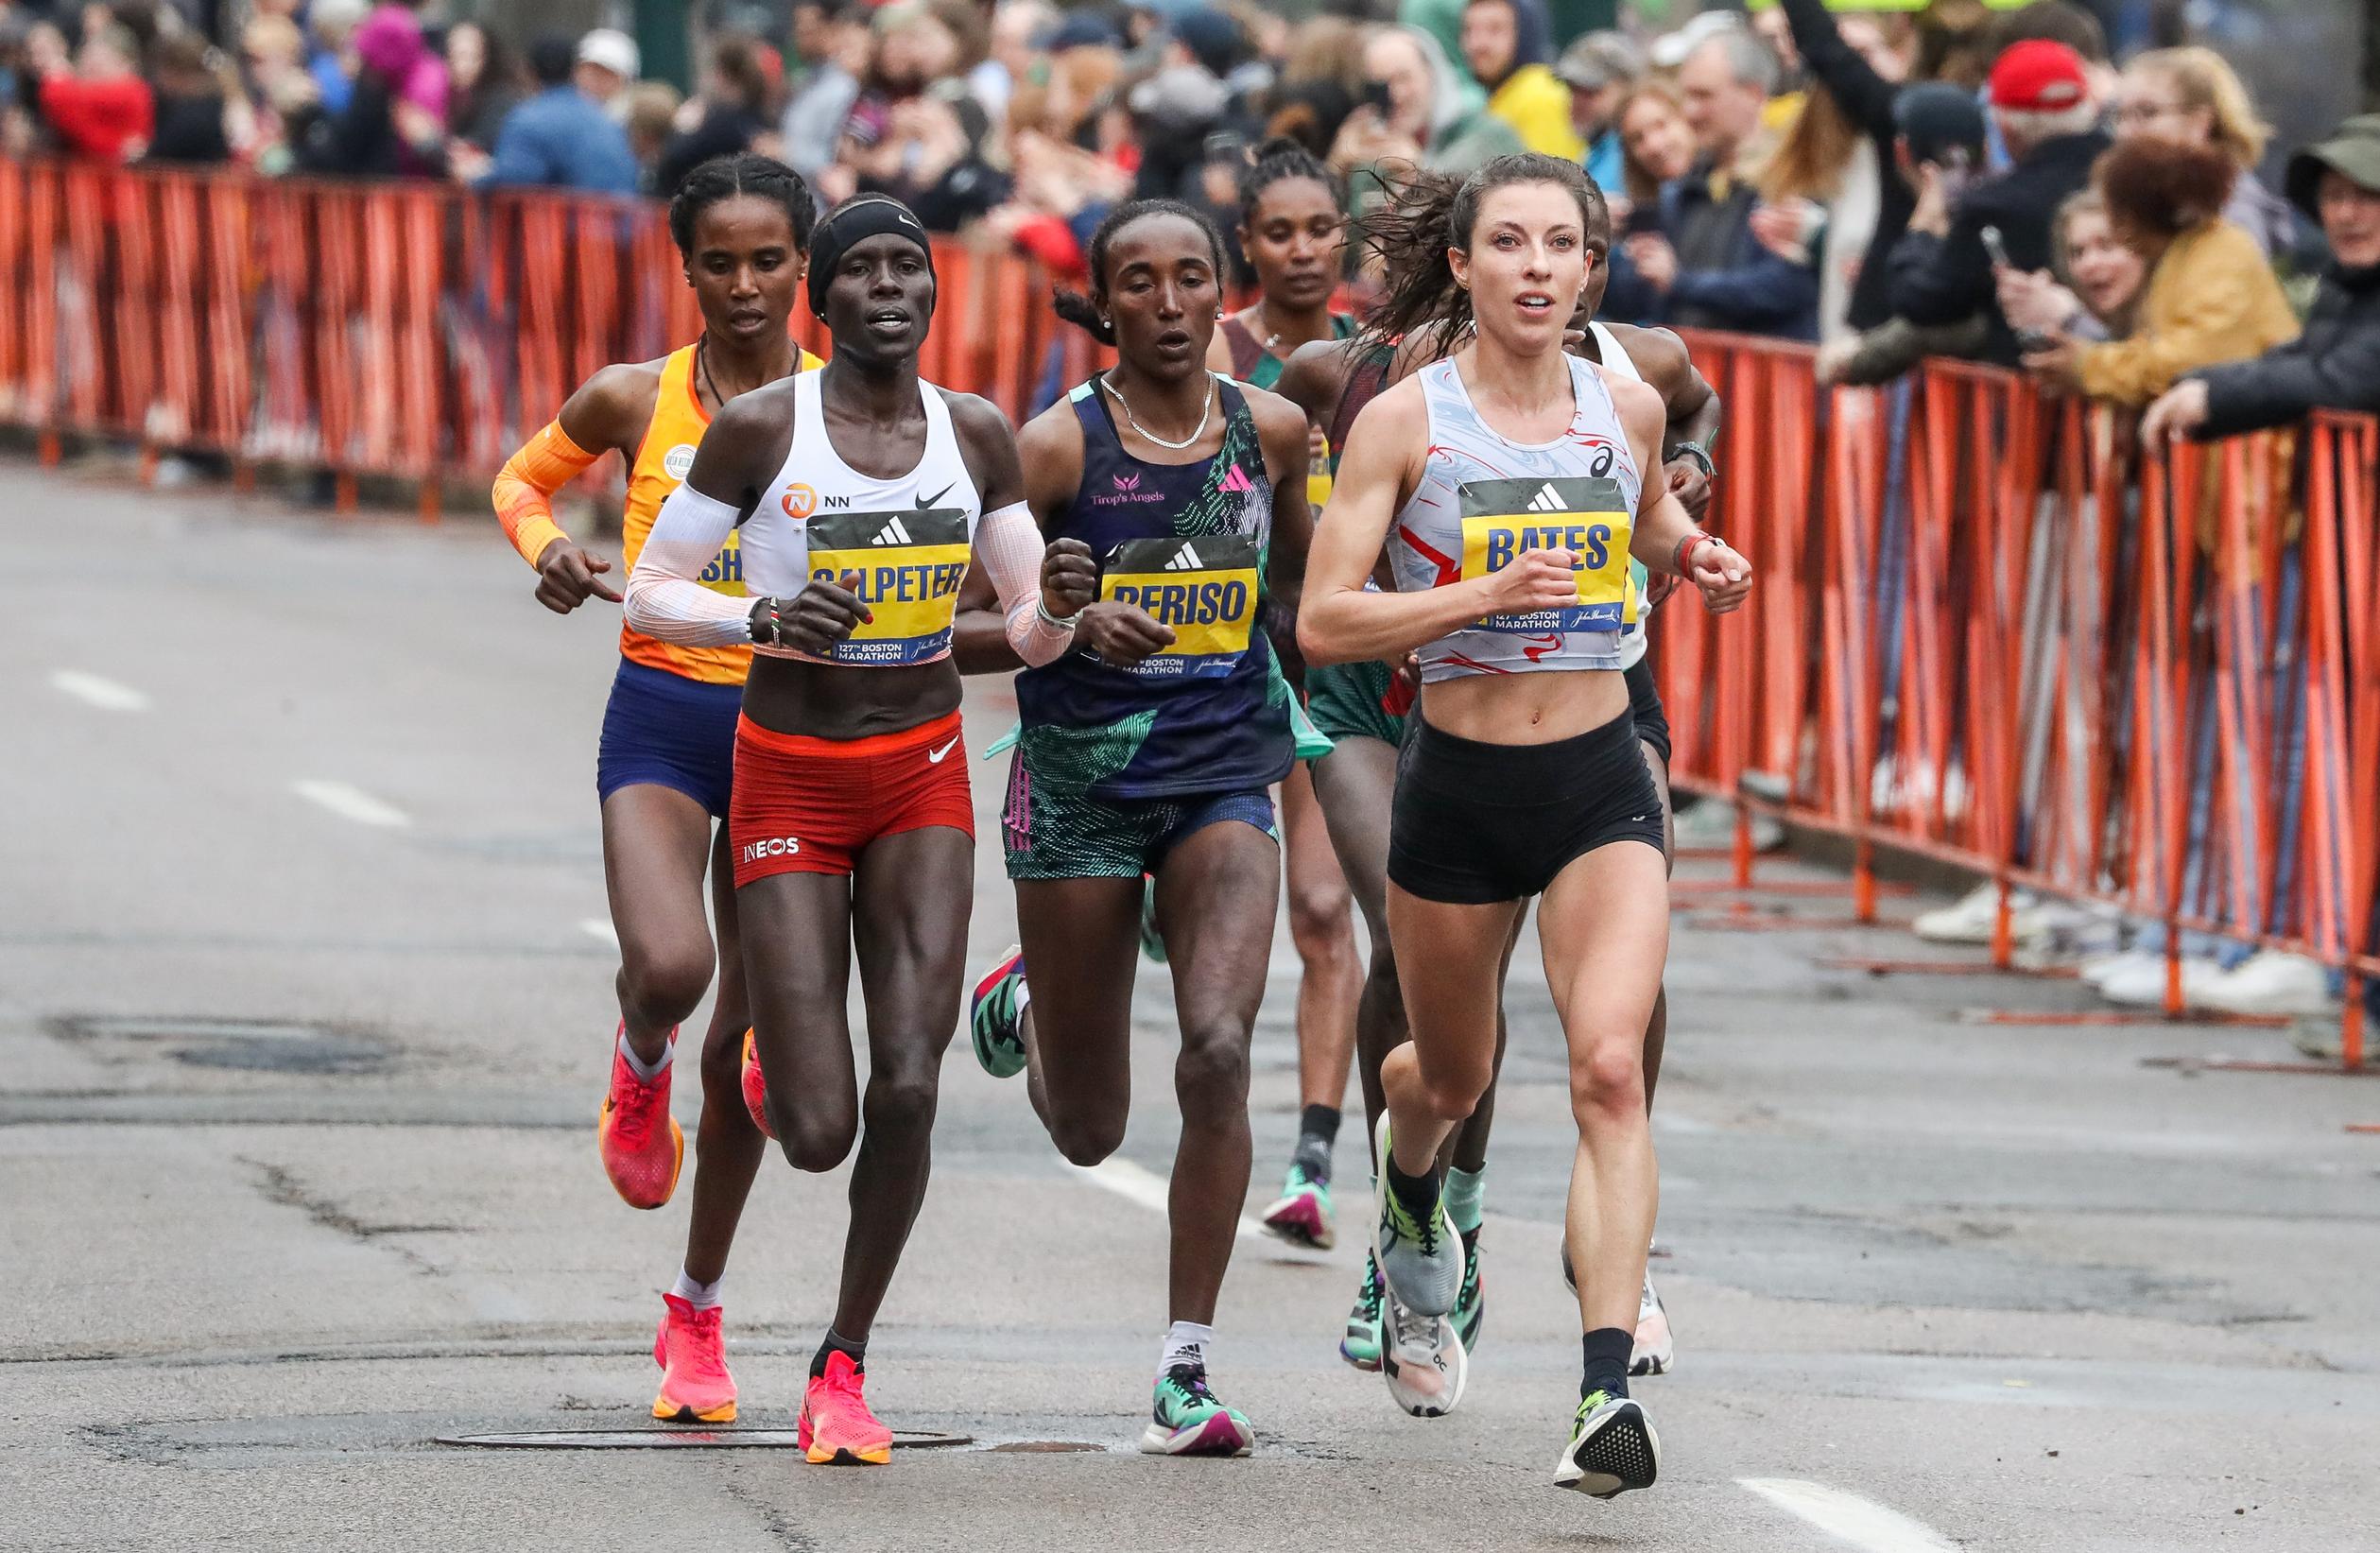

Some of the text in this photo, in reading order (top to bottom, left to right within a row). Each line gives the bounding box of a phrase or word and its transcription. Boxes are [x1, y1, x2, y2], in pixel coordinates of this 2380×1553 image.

[824, 496, 850, 508] NN
[1091, 491, 1165, 506] Tirop's Angels
[697, 549, 746, 582] SH
[1495, 619, 1560, 629] MARATHON
[861, 644, 902, 653] BOSTON
[838, 651, 902, 661] MARATHON
[1145, 658, 1184, 667] BOSTON
[1122, 665, 1183, 675] MARATHON
[743, 837, 800, 864] INEOS
